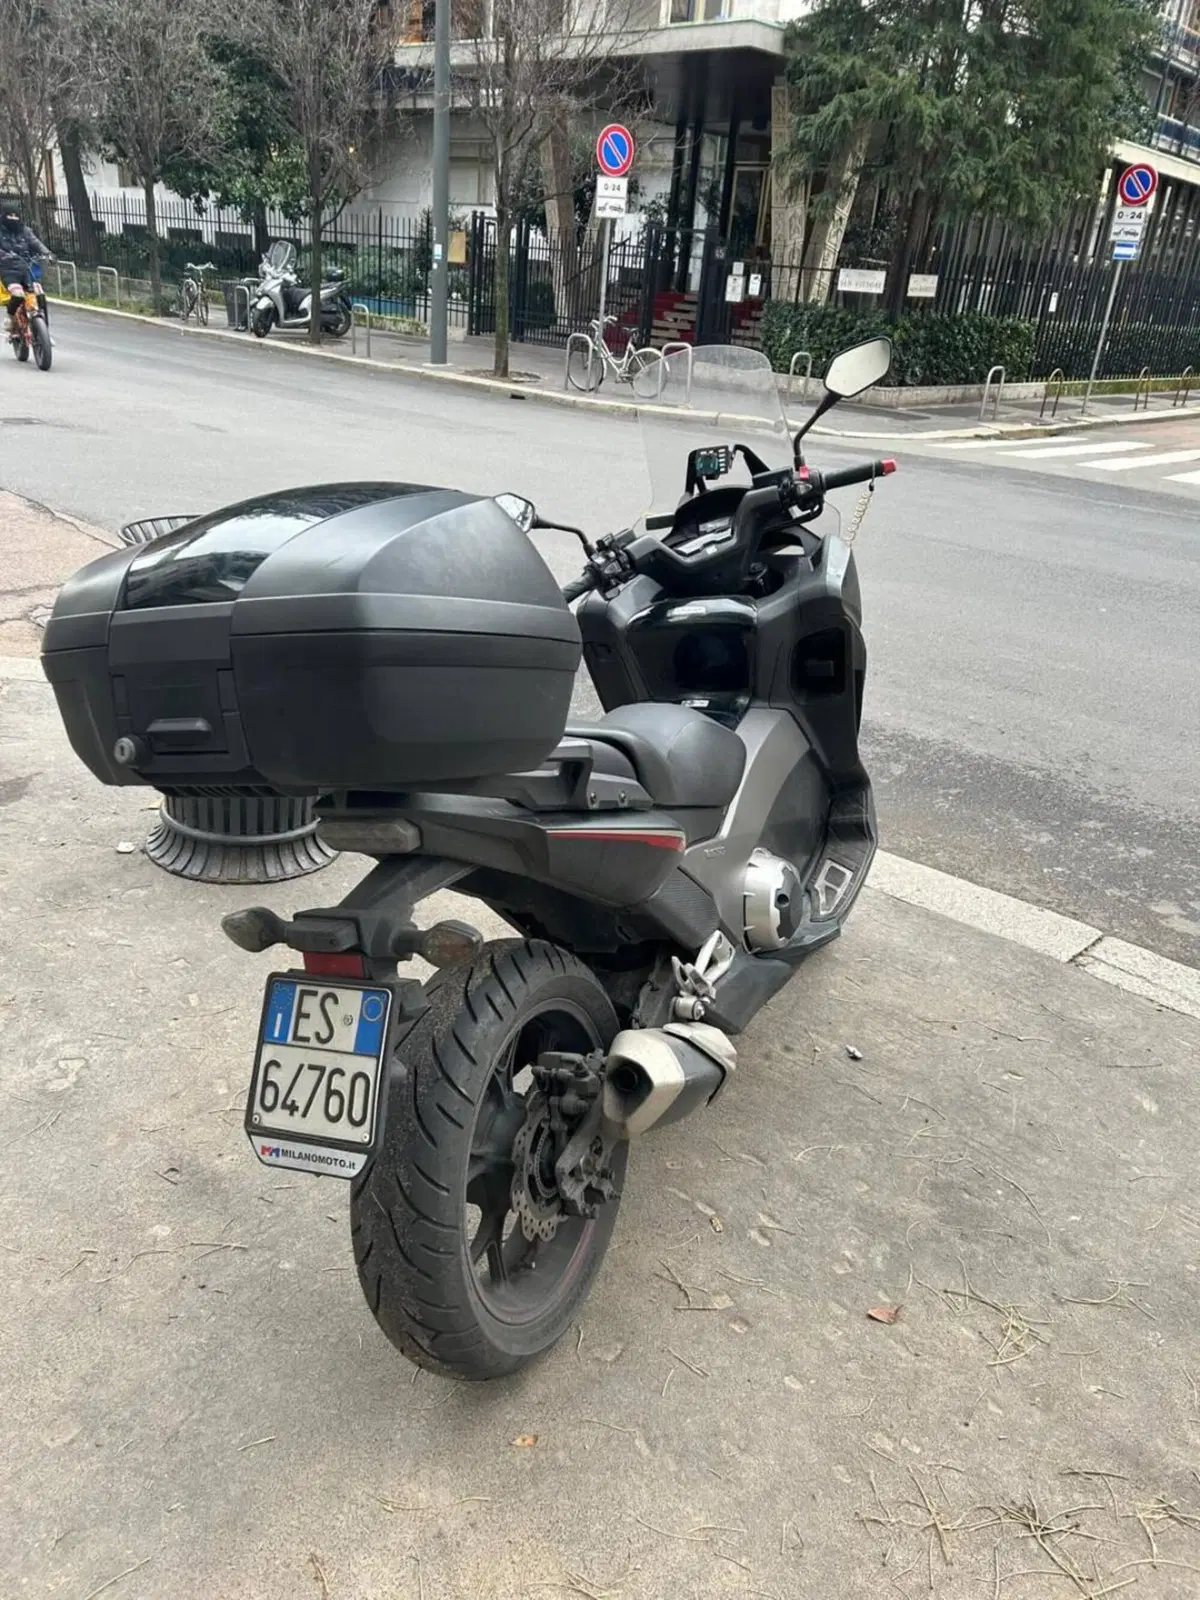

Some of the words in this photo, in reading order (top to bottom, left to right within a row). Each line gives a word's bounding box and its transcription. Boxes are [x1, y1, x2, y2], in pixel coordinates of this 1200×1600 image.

[292, 988, 340, 1045] ES
[259, 1059, 371, 1128] 64760
[281, 1147, 356, 1171] MILANOMOTO.it
